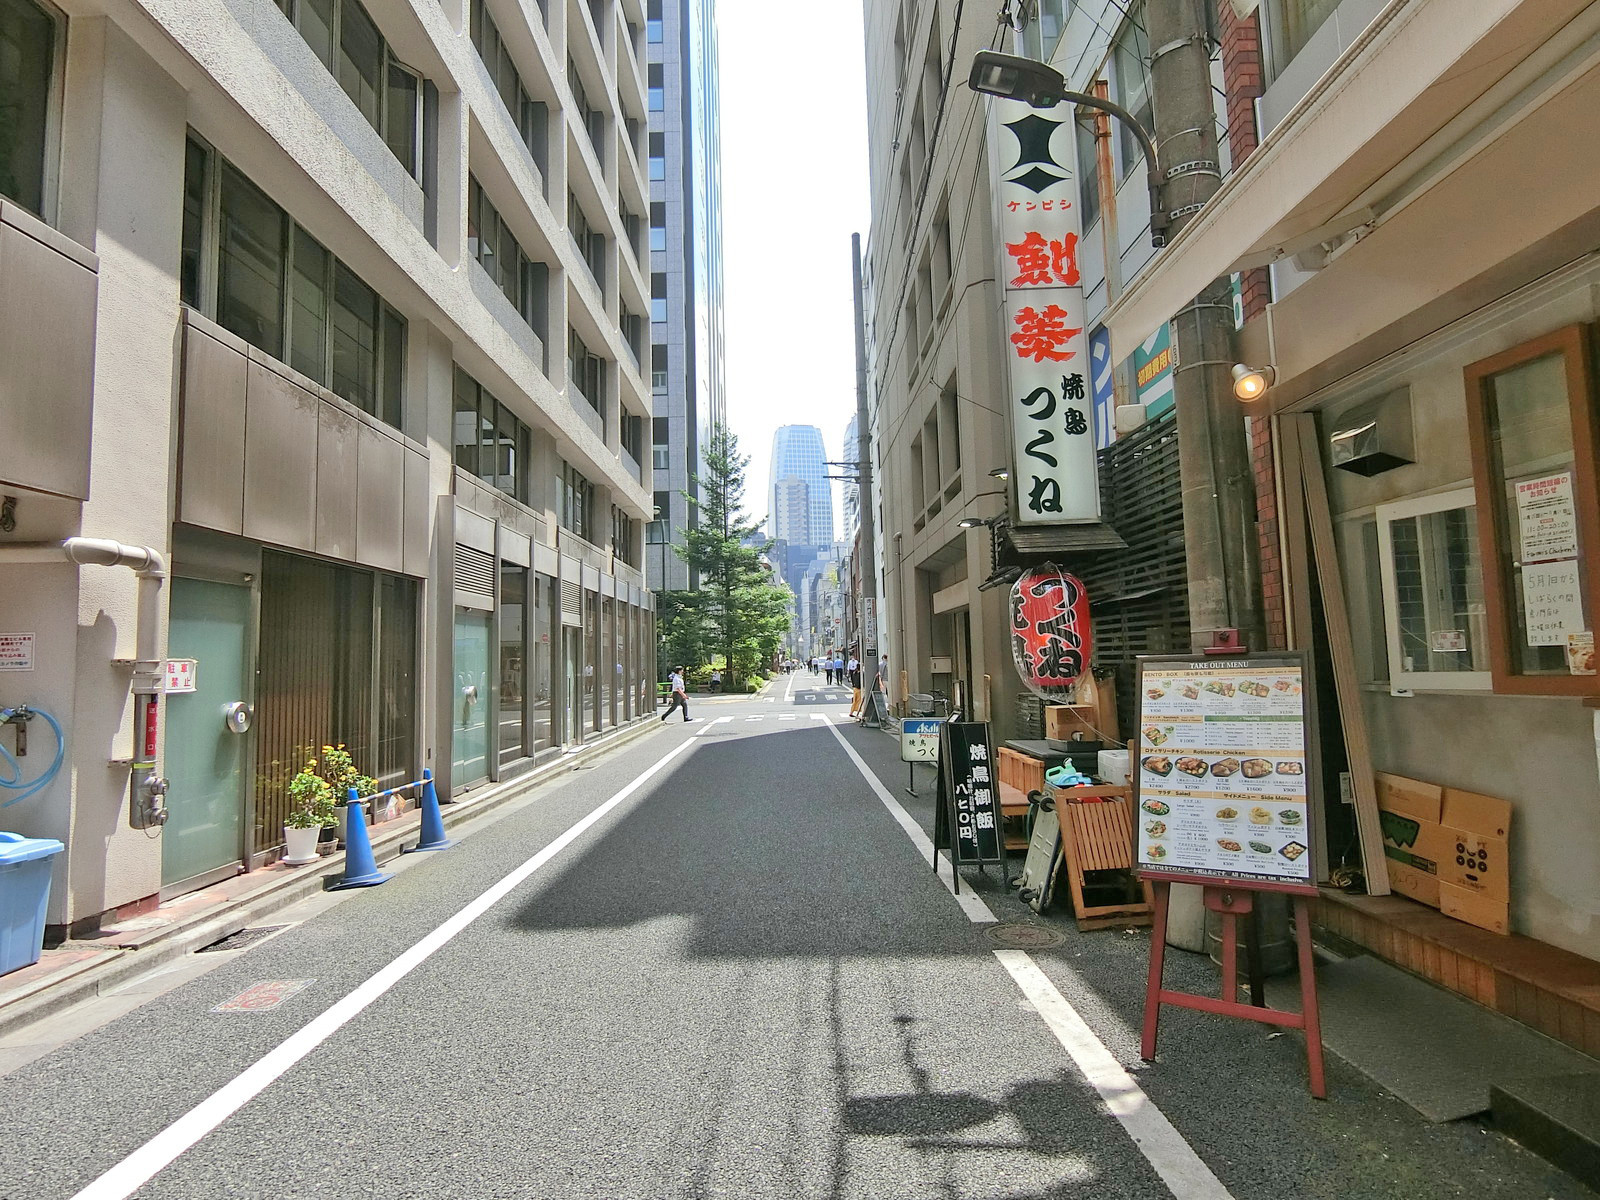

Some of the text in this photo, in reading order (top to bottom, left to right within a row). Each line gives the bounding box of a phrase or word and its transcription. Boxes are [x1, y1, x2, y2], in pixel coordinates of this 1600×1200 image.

[1007, 200, 1072, 212] ケンビシ
[1061, 372, 1088, 436] 焼鳥
[1020, 386, 1063, 514] つくね
[1029, 577, 1082, 679] つくね
[167, 663, 188, 674] 駐車
[1210, 661, 1226, 669] OUT
[171, 677, 191, 688] 禁止
[908, 739, 927, 747] 焼鳥
[969, 744, 994, 829] 焼鳥御飯
